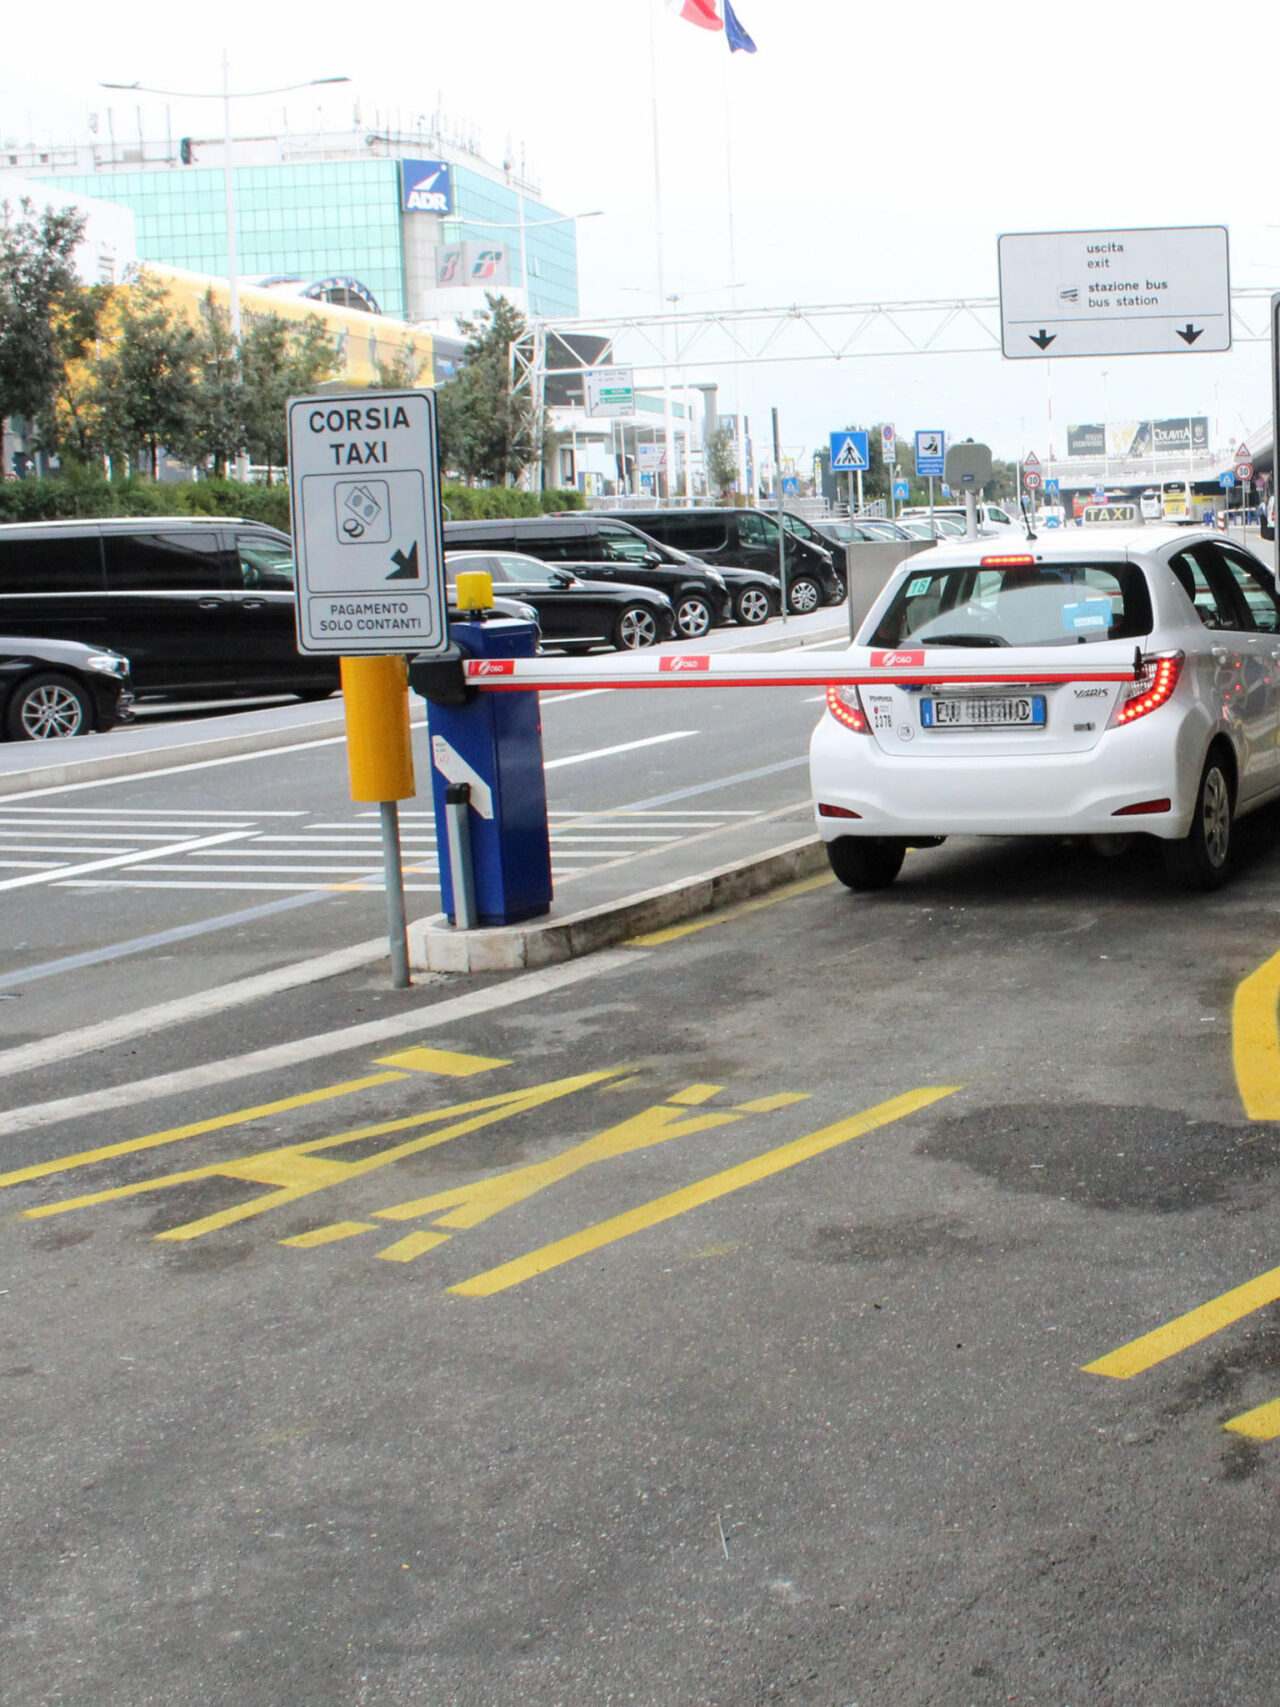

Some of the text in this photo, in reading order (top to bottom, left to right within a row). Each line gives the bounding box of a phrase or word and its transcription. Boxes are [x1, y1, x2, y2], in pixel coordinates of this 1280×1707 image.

[407, 191, 449, 211] ADR
[1086, 242, 1124, 254] uscita
[1087, 258, 1110, 269] exit
[1088, 280, 1169, 293] stazione bus
[1088, 295, 1159, 308] bus station
[309, 406, 411, 434] CORSIA
[329, 441, 388, 465] TAXI
[1238, 467, 1250, 476] 30
[1028, 476, 1039, 485] 30
[1087, 507, 1131, 521] TAXI
[910, 579, 928, 594] 18
[330, 602, 410, 616] PAGAMENTO
[320, 618, 422, 632] SOLO CONTANTI
[0, 1046, 964, 1298] TAXI
